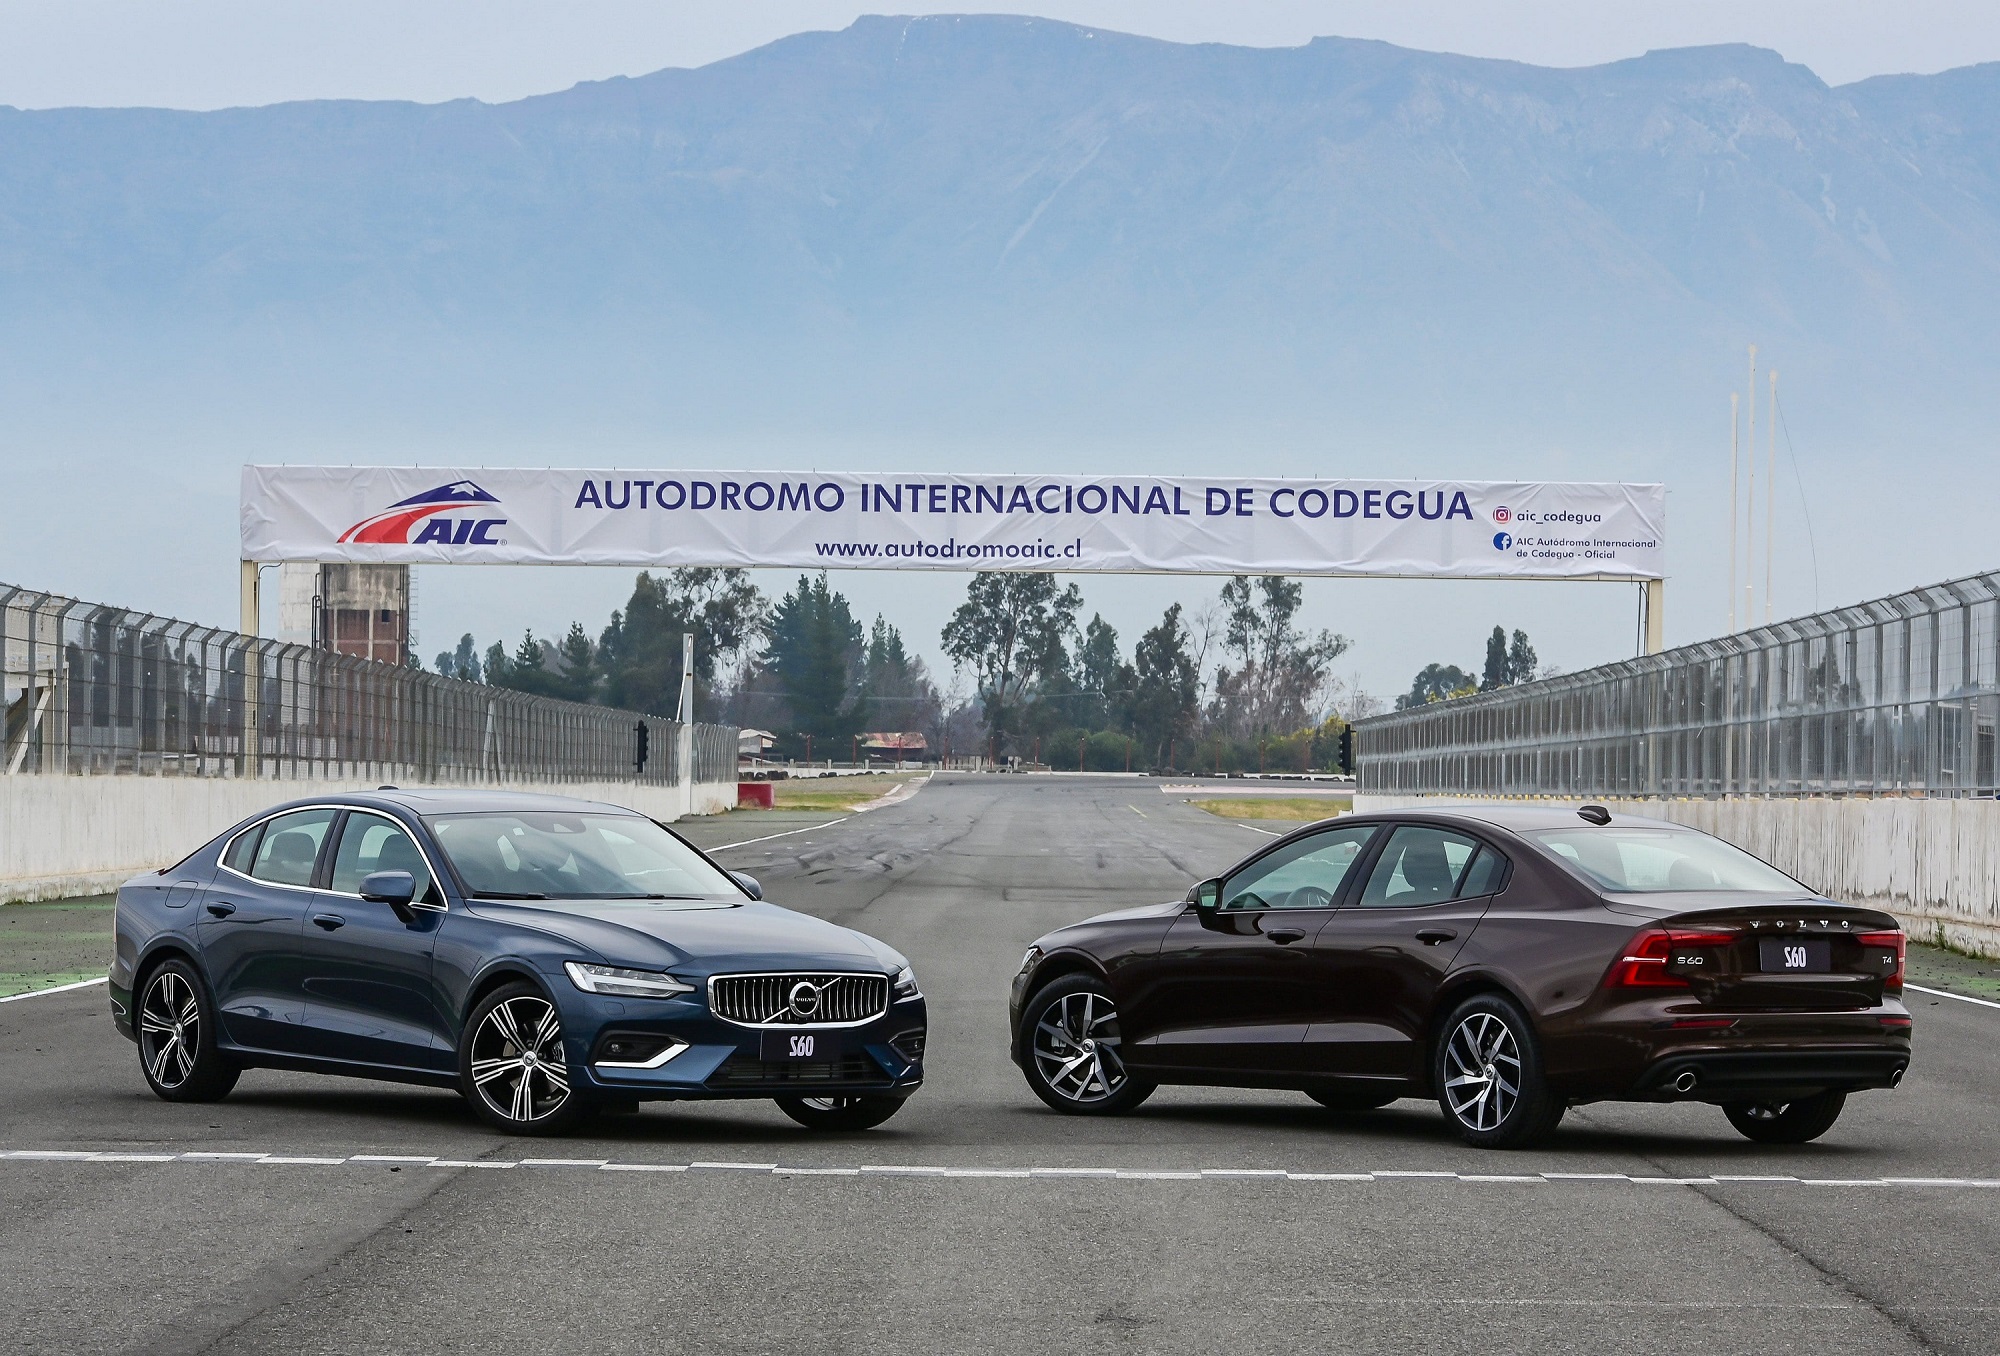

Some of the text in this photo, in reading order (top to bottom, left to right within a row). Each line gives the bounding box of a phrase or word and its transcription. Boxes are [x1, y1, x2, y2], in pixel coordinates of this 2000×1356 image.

[574, 480, 1474, 521] AUTODROMO INTERNACIONAL DE CODEGUA
[1516, 509, 1601, 525] aic_codegua
[412, 518, 508, 546] AIC
[815, 537, 1081, 558] www.autodromoaic.cl
[1516, 537, 1534, 546] AIC
[1593, 538, 1656, 548] Internacional
[1516, 549, 1528, 558] de
[1531, 549, 1575, 560] Codegua
[1584, 550, 1615, 559] Oficial
[1750, 920, 1850, 929] VOLVO
[1677, 956, 1704, 965] S60
[1784, 946, 1807, 968] S60
[1882, 956, 1892, 965] T4
[789, 1035, 815, 1057] S60
